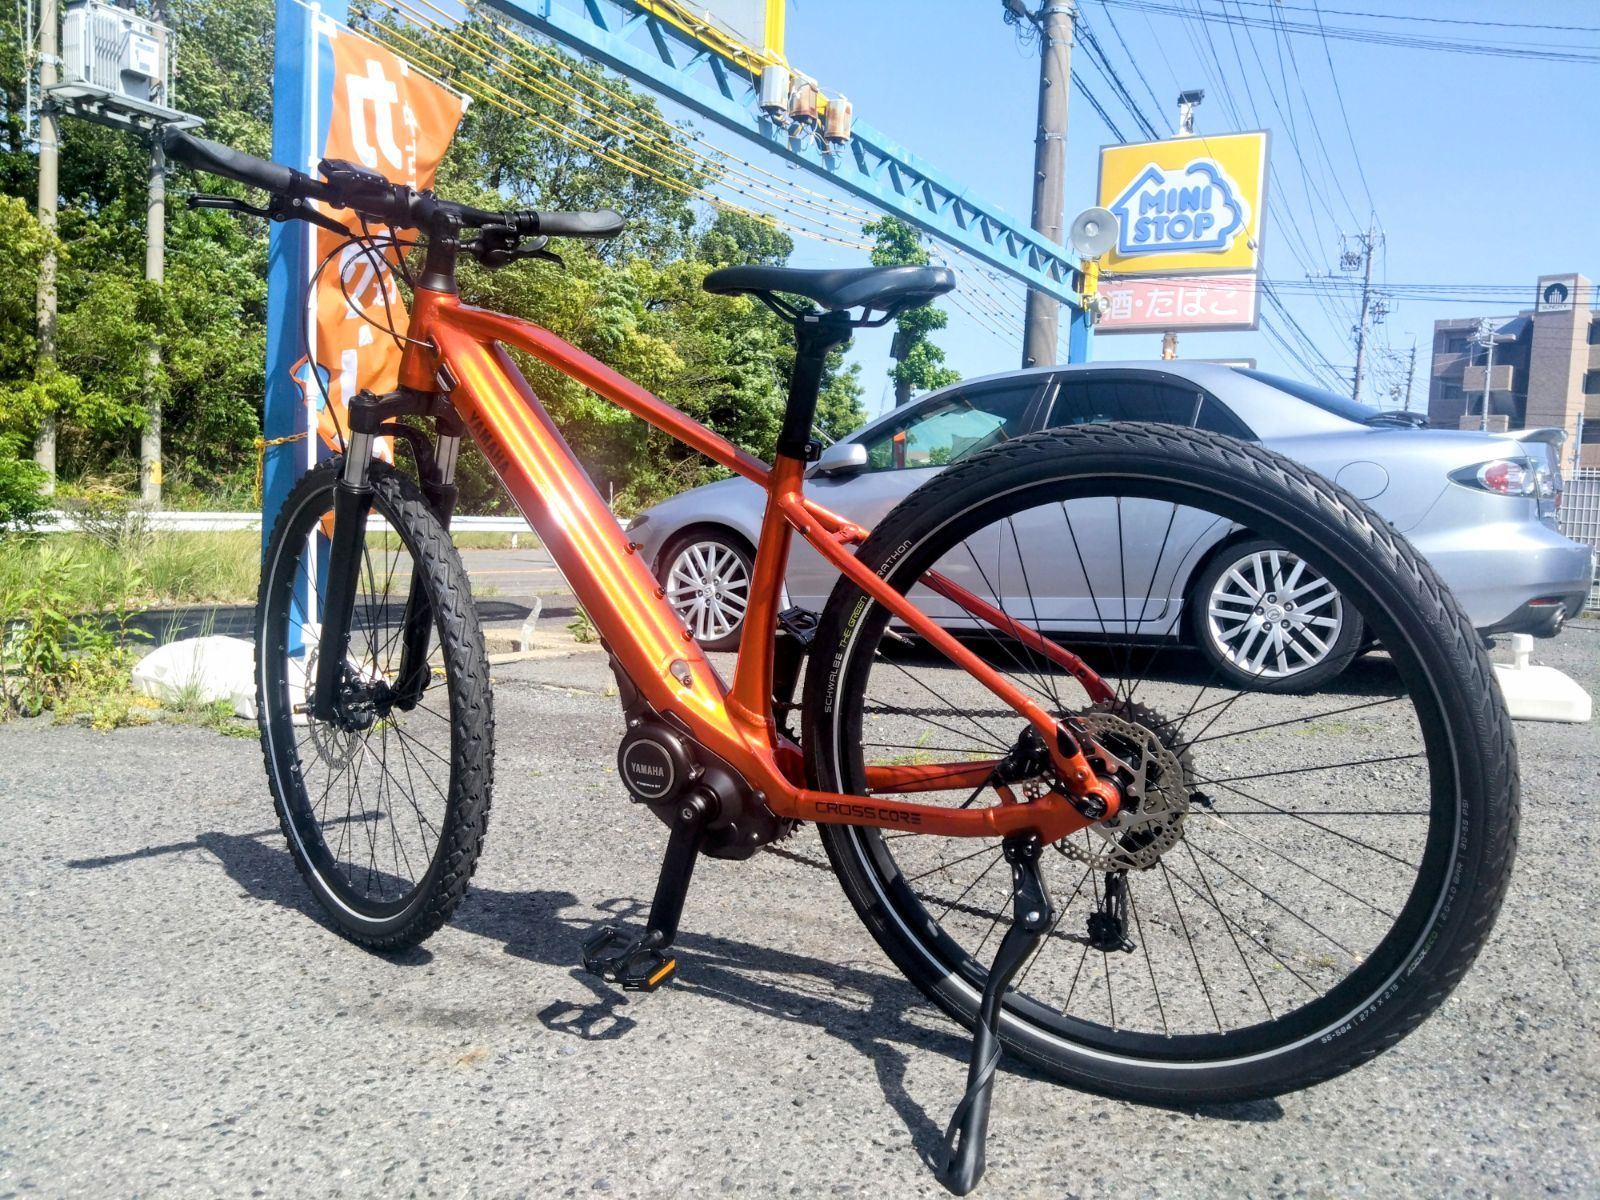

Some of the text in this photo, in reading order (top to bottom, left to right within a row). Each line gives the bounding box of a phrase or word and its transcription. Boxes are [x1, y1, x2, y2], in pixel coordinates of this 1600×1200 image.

[1139, 185, 1212, 215] MINI
[1134, 213, 1215, 243] STOP
[470, 410, 510, 473] YAMAHA
[824, 539, 913, 713] SCHWALBE THE GREEN RATHON
[631, 762, 665, 777] YAMAHA
